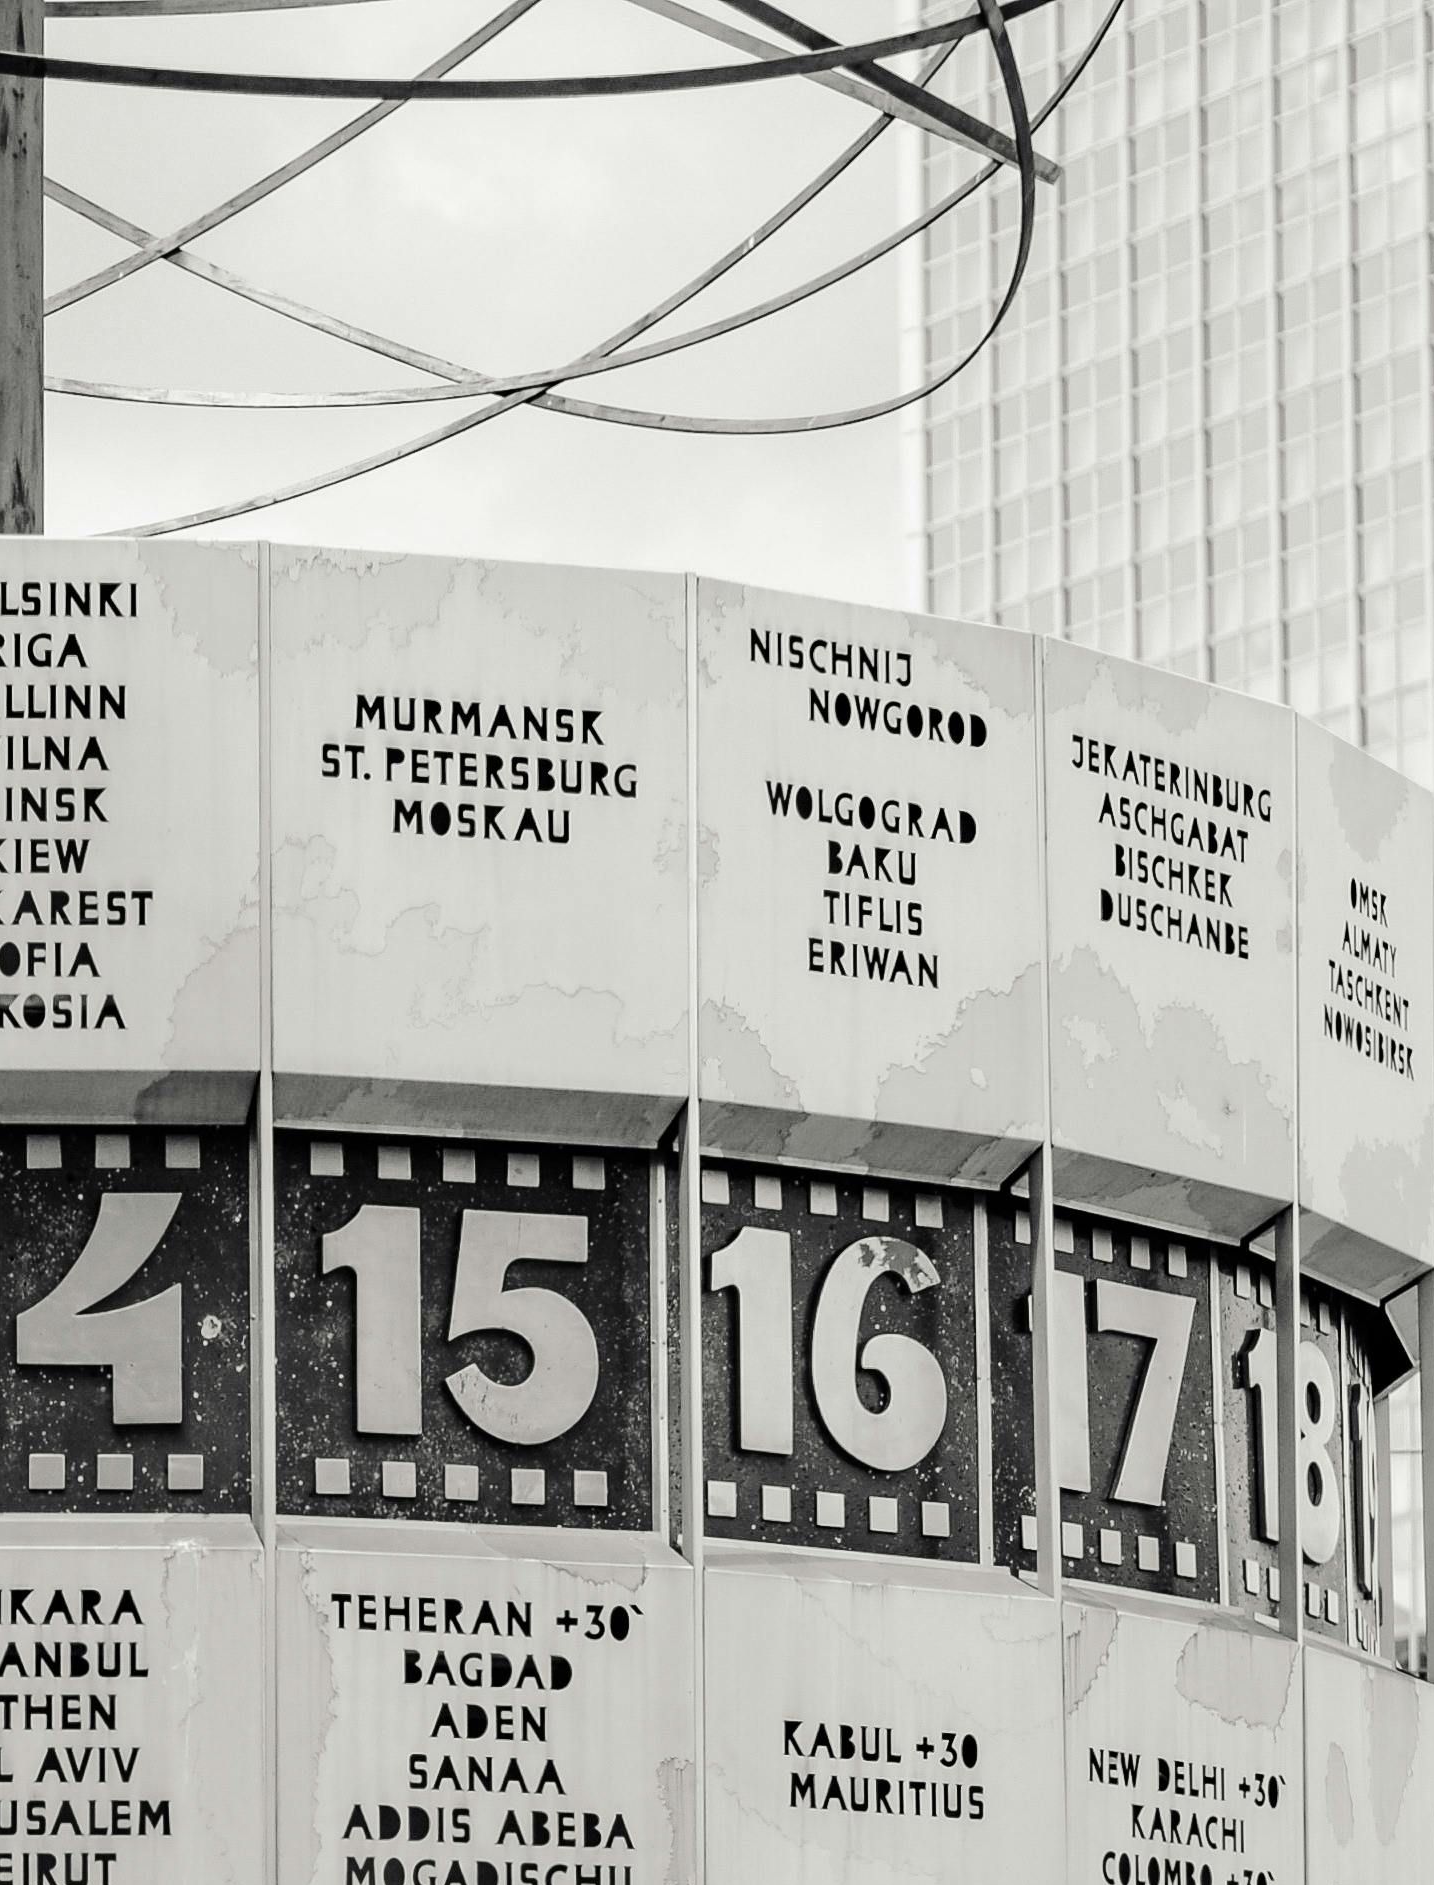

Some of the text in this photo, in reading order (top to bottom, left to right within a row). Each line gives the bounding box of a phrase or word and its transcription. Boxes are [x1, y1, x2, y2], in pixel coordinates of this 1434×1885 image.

[750, 627, 912, 688] NISCHNIJ
[355, 693, 605, 746] MURMANSK
[809, 687, 988, 748] NOWGOROD
[321, 743, 637, 799] ST. PETERSBURG
[1071, 734, 1272, 823] JEKATERINBURG
[392, 798, 570, 844] MOSKAU
[765, 780, 977, 844] WOLGOGRAD
[1098, 792, 1249, 863] ASCHGABAT
[828, 839, 917, 886] BAKU
[1114, 843, 1233, 908] BISCHKEK
[823, 889, 923, 937] TIFLIS
[1100, 888, 1249, 960] DUSCHANBE
[1350, 877, 1388, 928] OMSK
[808, 937, 939, 989] ERIWAN
[1342, 921, 1397, 974] ALMATY
[1328, 959, 1409, 1027] TASCHKENT
[1324, 1004, 1414, 1081] NOWOSIBIRSK
[322, 1204, 599, 1445] 15
[711, 1226, 947, 1472] 16
[1029, 1270, 1197, 1507] 17
[1245, 1328, 1340, 1563] 18
[330, 1592, 532, 1638] TEHERAN
[403, 1648, 573, 1691] BAGDAD
[430, 1702, 547, 1743] ADEN
[783, 1719, 978, 1769] KABUL +30
[34, 1746, 140, 1784] AVIV
[408, 1753, 567, 1796] SANAA
[1089, 1747, 1141, 1789] NEW
[1157, 1757, 1225, 1802] DELHI
[789, 1772, 984, 1820] MAURITIUS
[341, 1803, 636, 1850] ADDIS ABEBA
[1131, 1803, 1245, 1854] KARACHI
